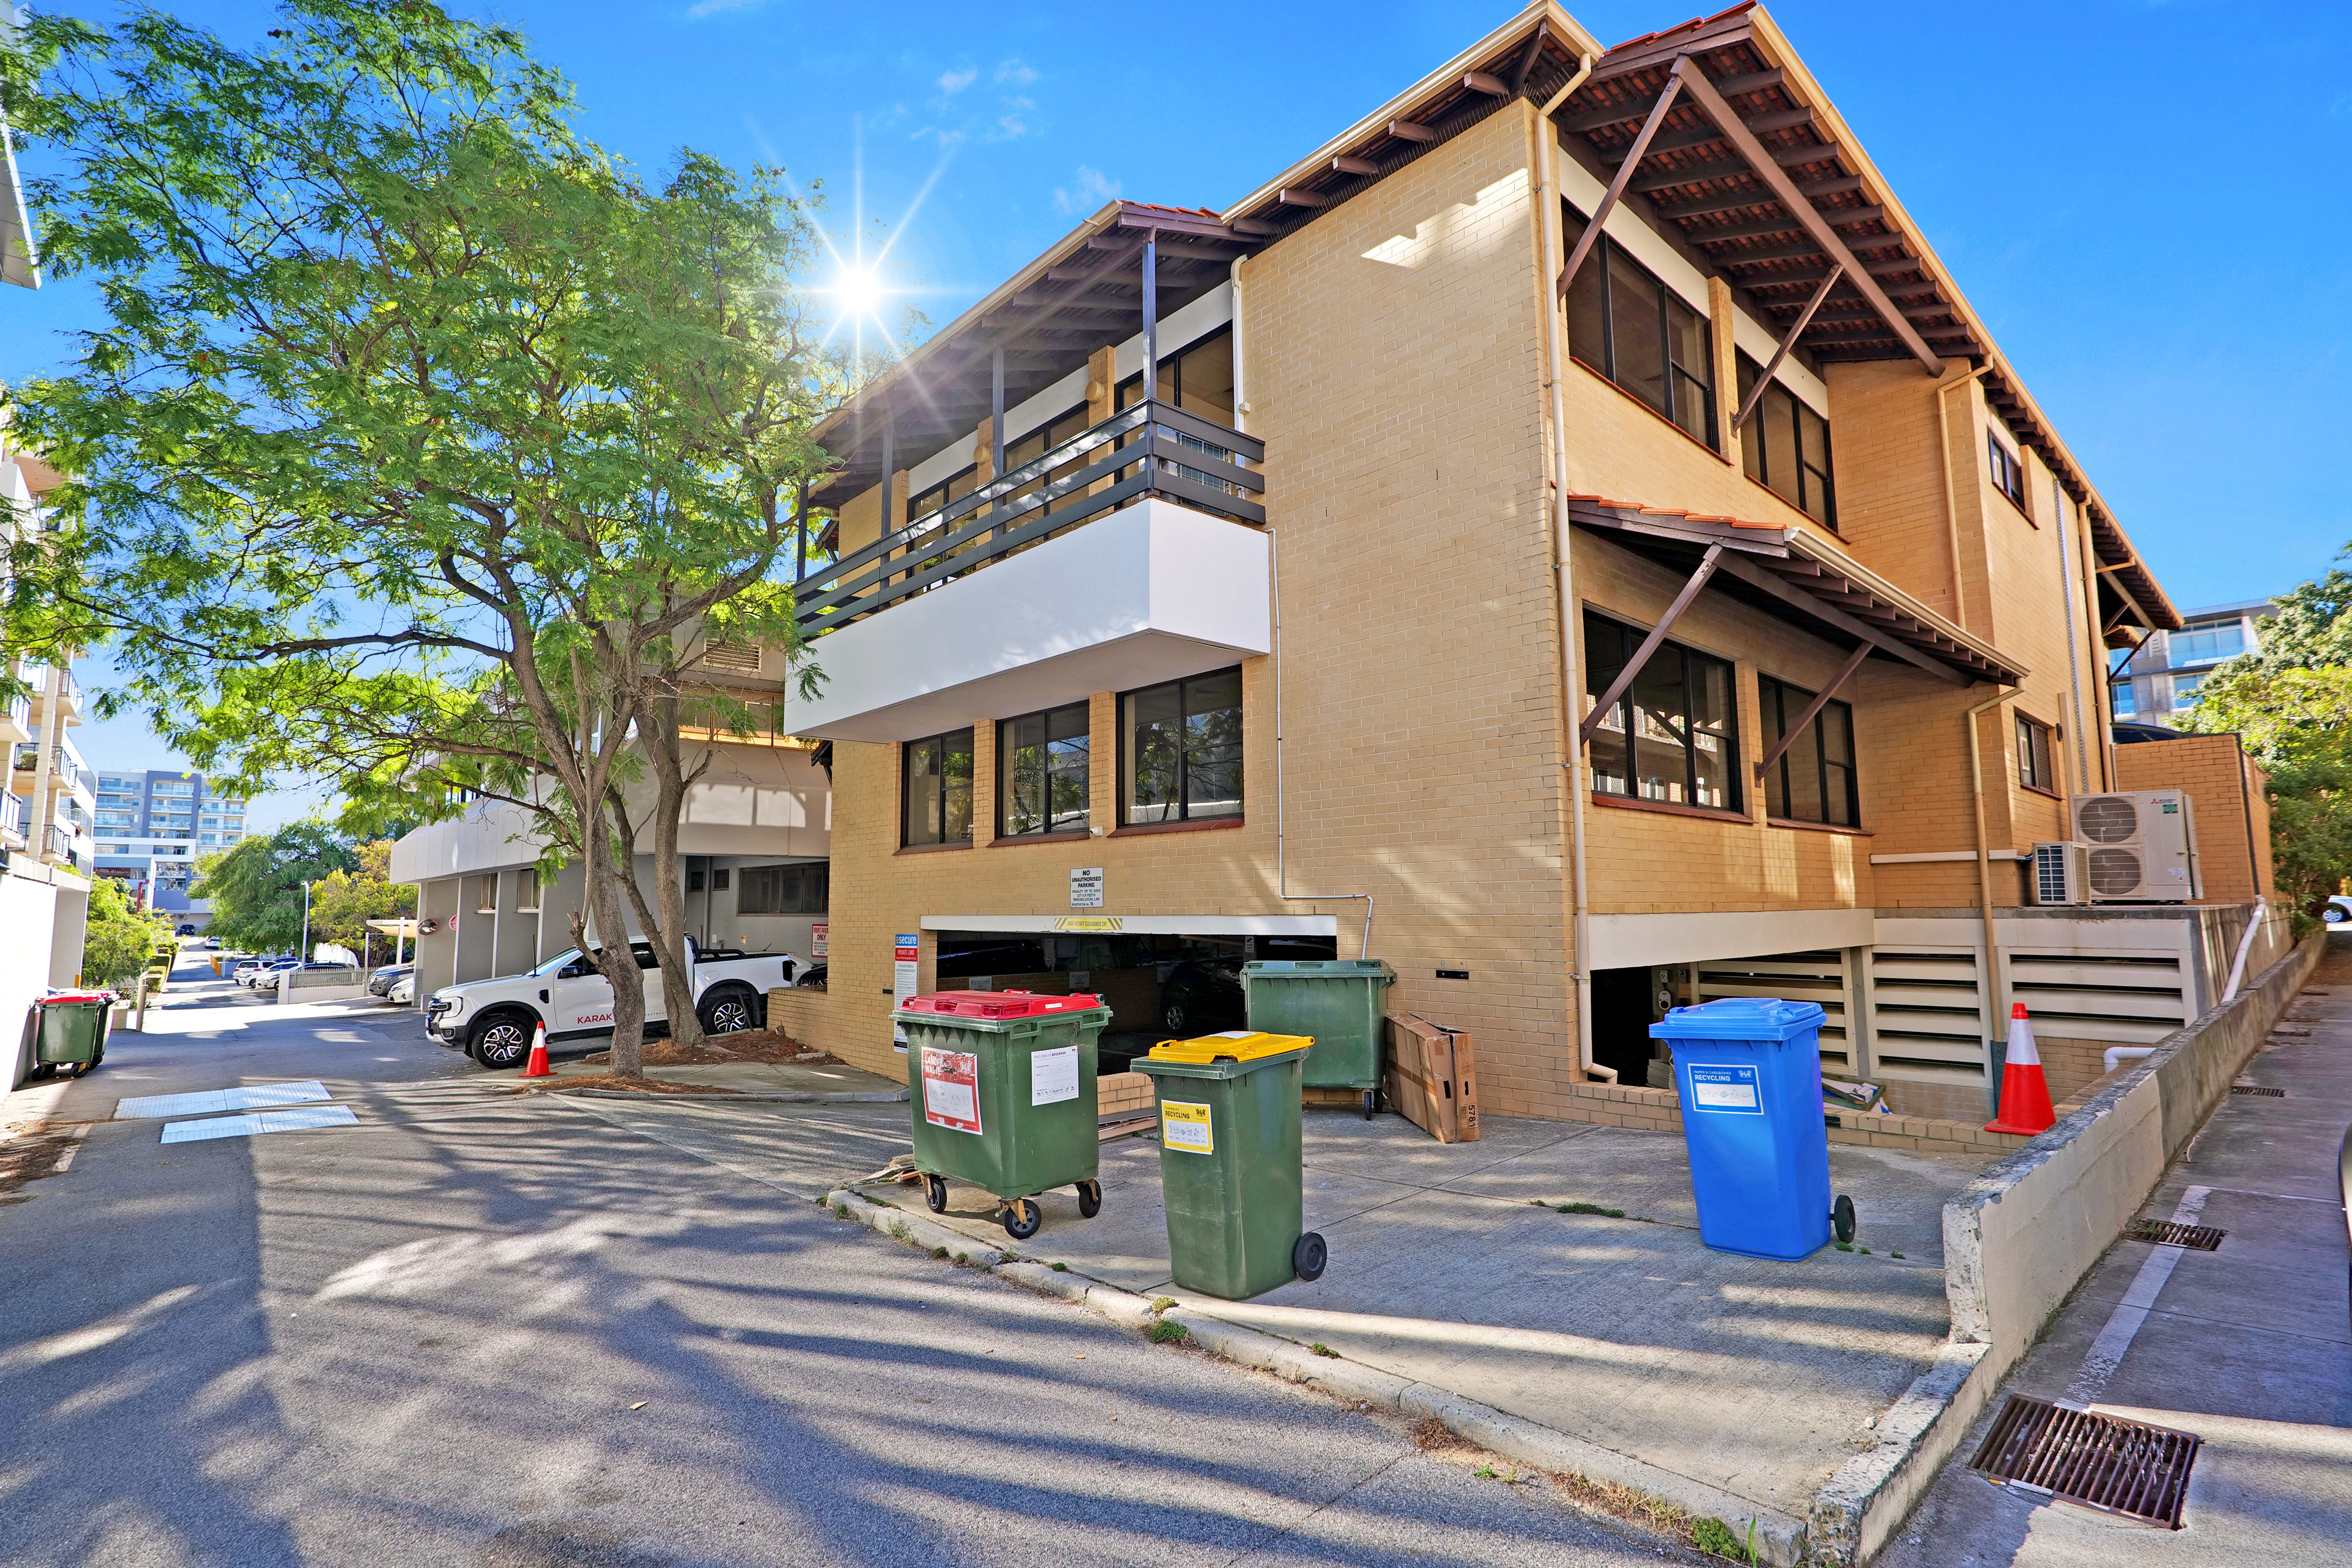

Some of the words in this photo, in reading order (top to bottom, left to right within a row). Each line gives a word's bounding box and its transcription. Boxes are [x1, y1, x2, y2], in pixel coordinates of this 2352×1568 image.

[899, 936, 916, 944] secure
[577, 1013, 612, 1024] KARAK
[925, 1065, 941, 1076] WASTE
[1165, 1111, 1190, 1119] RECYCLING
